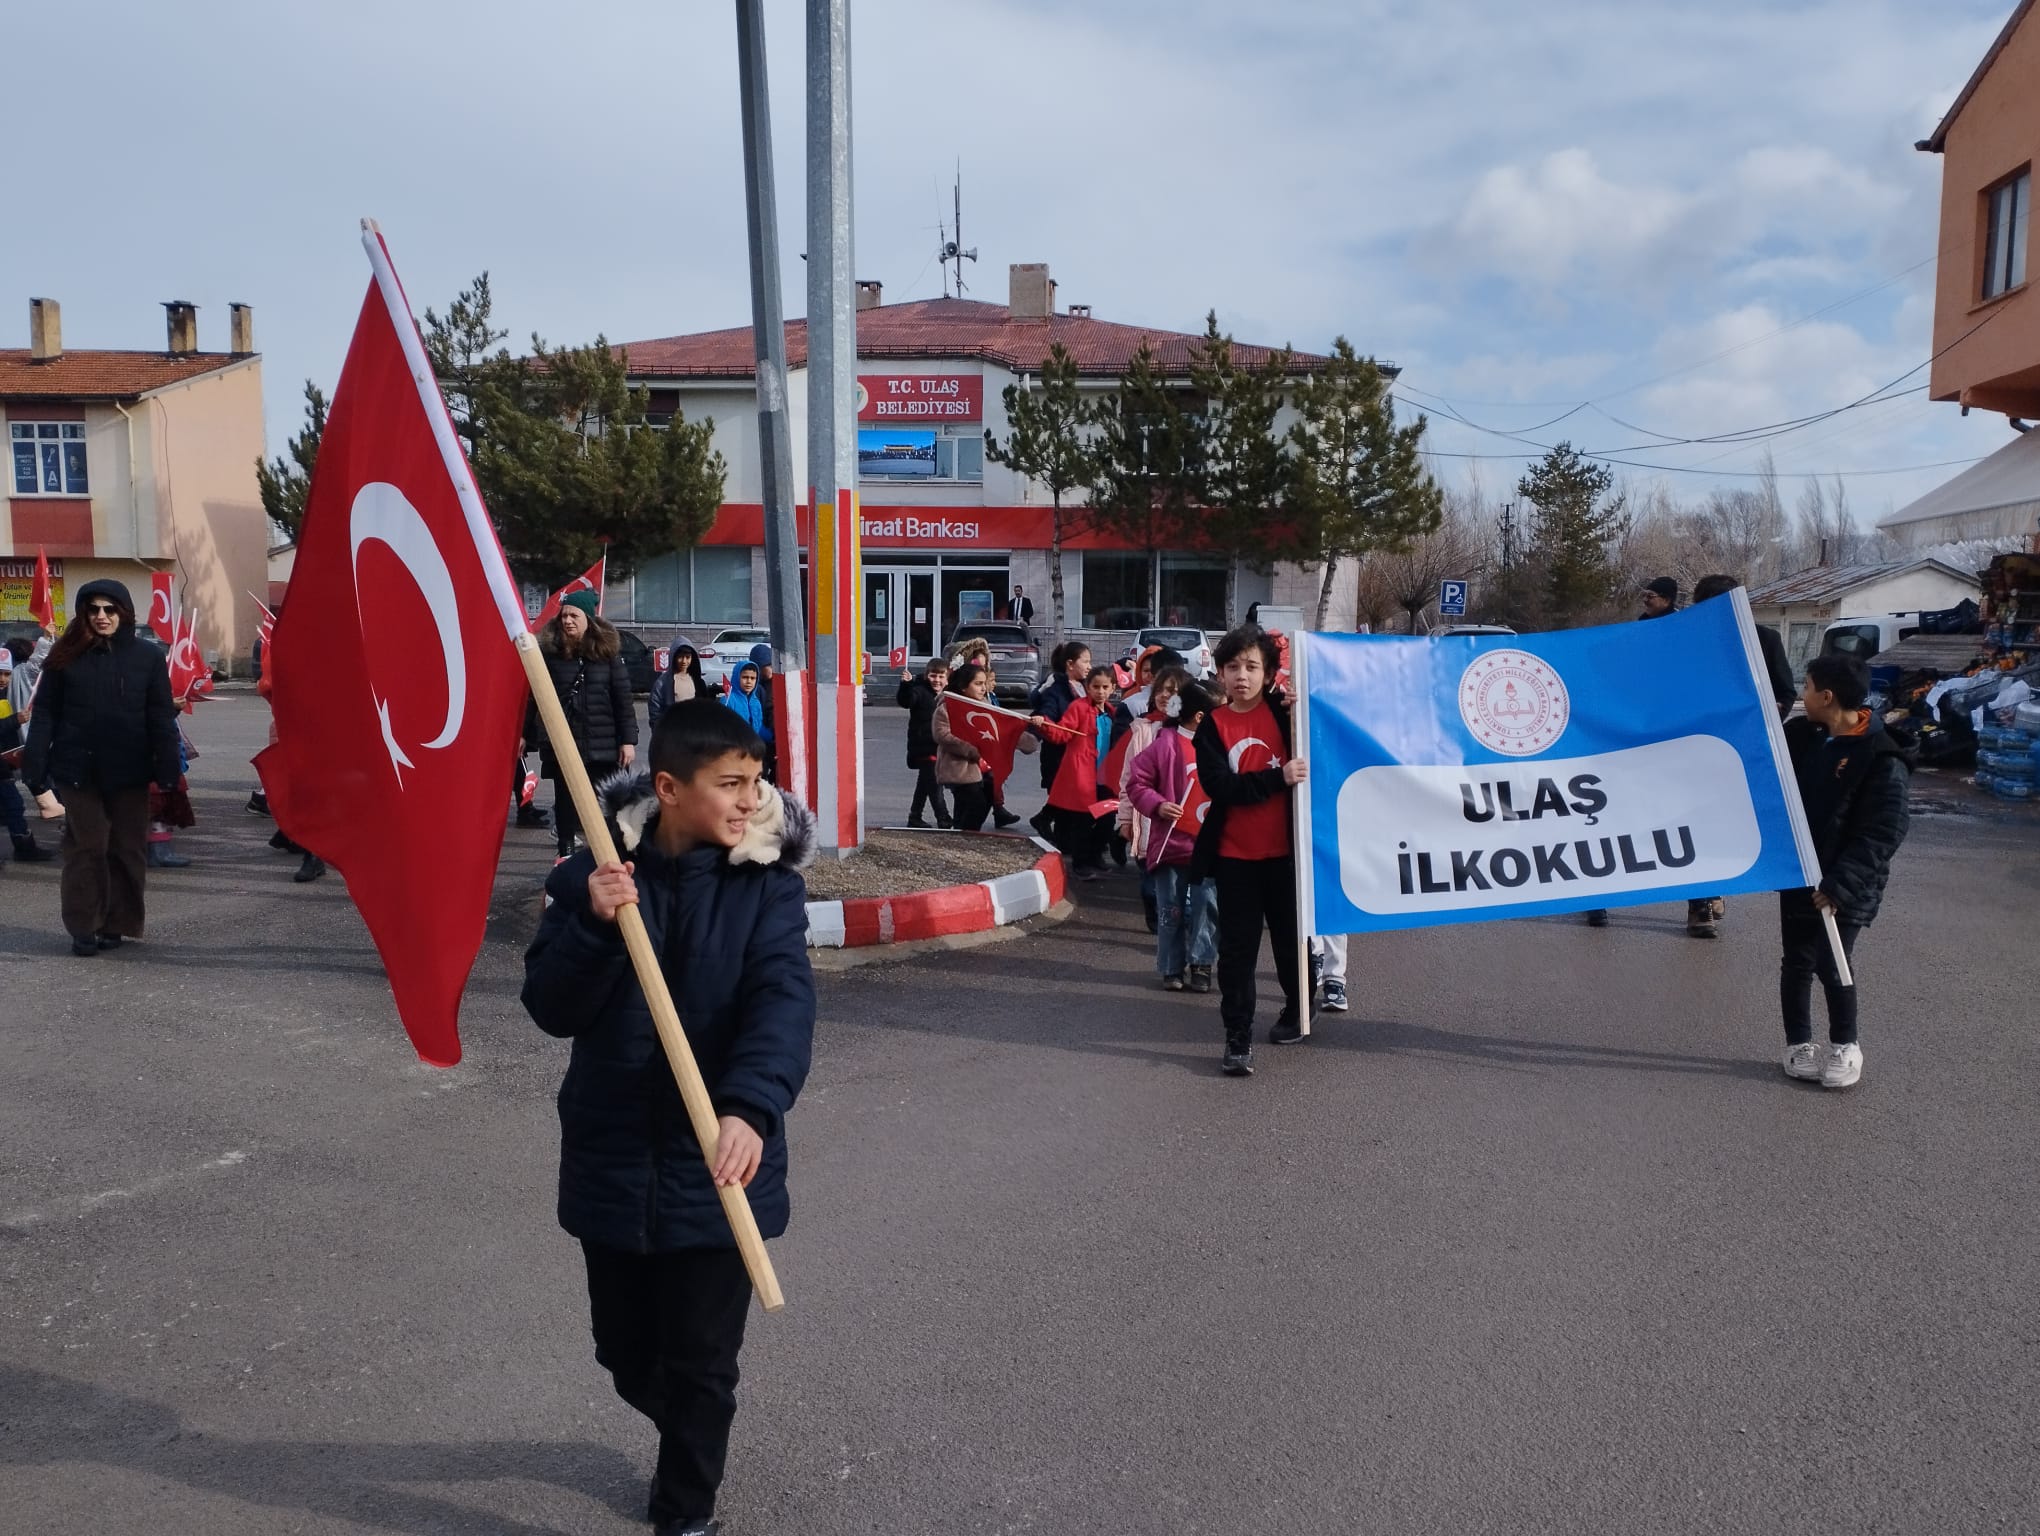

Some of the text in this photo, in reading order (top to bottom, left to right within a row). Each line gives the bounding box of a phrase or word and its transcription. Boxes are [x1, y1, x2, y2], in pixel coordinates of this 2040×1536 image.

[888, 380, 959, 398] T.C. ULAŞ
[876, 397, 971, 415] BELEDİYESİ
[860, 516, 979, 539] iraat Bankası
[0, 562, 63, 578] TÜTÜCÜ
[1445, 583, 1460, 603] P
[1459, 773, 1608, 826] ULAŞ
[1398, 825, 1696, 896] İLKOKULU
